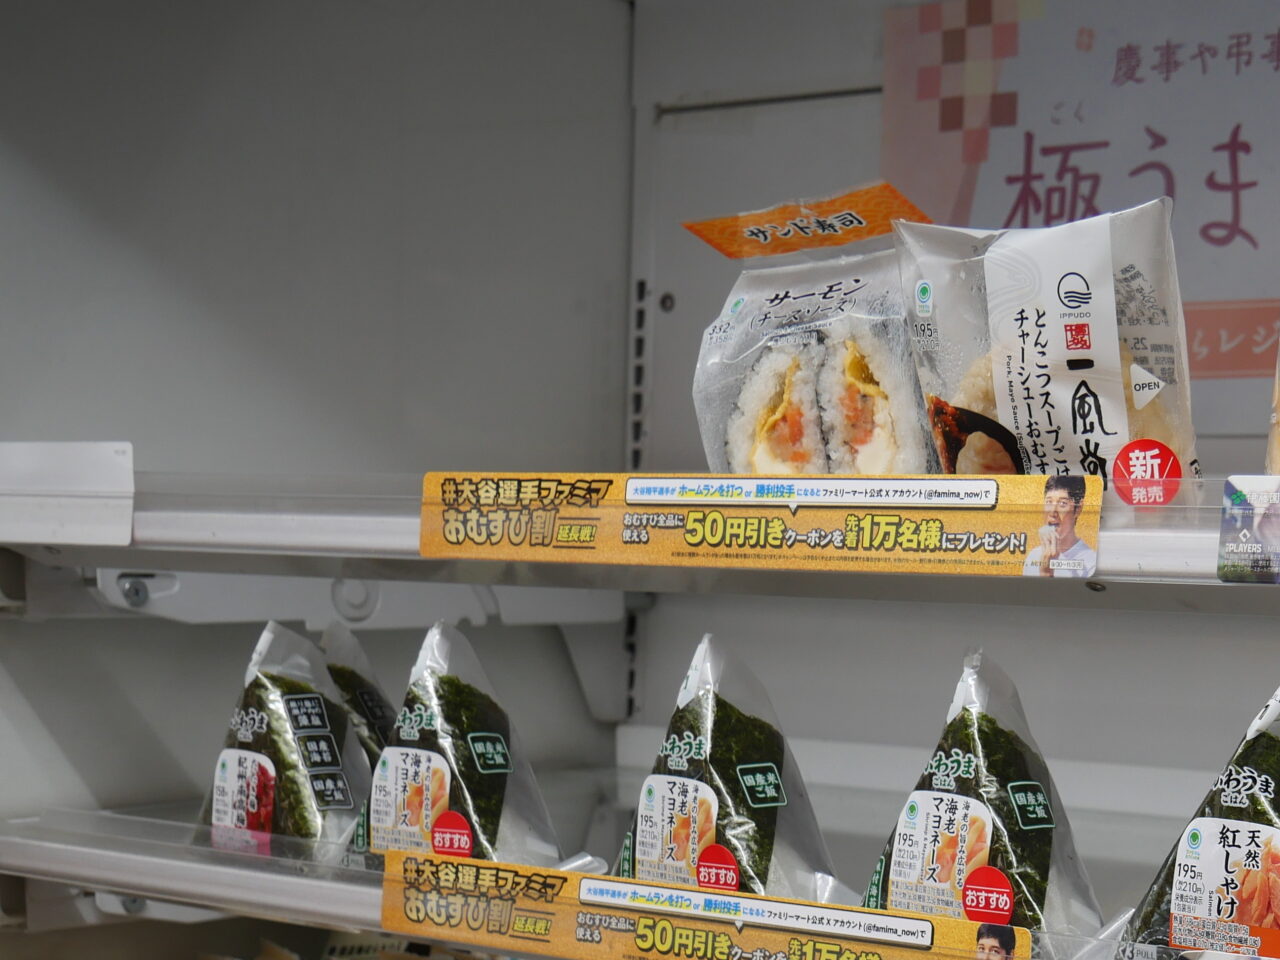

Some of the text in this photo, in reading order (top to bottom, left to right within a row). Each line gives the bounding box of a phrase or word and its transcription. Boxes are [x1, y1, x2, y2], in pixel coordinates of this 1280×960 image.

[745, 210, 865, 243] サンド寿司
[764, 278, 869, 308] サーモン
[1059, 311, 1092, 320] IPPUDO
[1133, 381, 1161, 393] OPEN
[1128, 449, 1161, 481] 新
[442, 507, 557, 546] おむすび割
[622, 513, 684, 527] おむすび全品に
[622, 528, 649, 544] 使える
[409, 752, 423, 786] 海老
[931, 776, 955, 790] ごはん
[399, 752, 410, 827] マヨネーズ
[677, 781, 690, 817] 海老
[1220, 791, 1249, 808] ごはん
[666, 780, 678, 862] マヨネーズ
[943, 797, 959, 836] 海老
[433, 831, 470, 850] おすすめ
[897, 832, 919, 849] 195円
[926, 796, 943, 884] マヨネーズ
[1242, 828, 1262, 870] 天然
[699, 866, 737, 887] おすすめ
[1176, 861, 1203, 881] 195円
[1215, 823, 1242, 922] 紅しゃけ
[403, 887, 515, 936] おむすび割
[965, 889, 1011, 910] おすすめ
[575, 926, 602, 944] 使える
